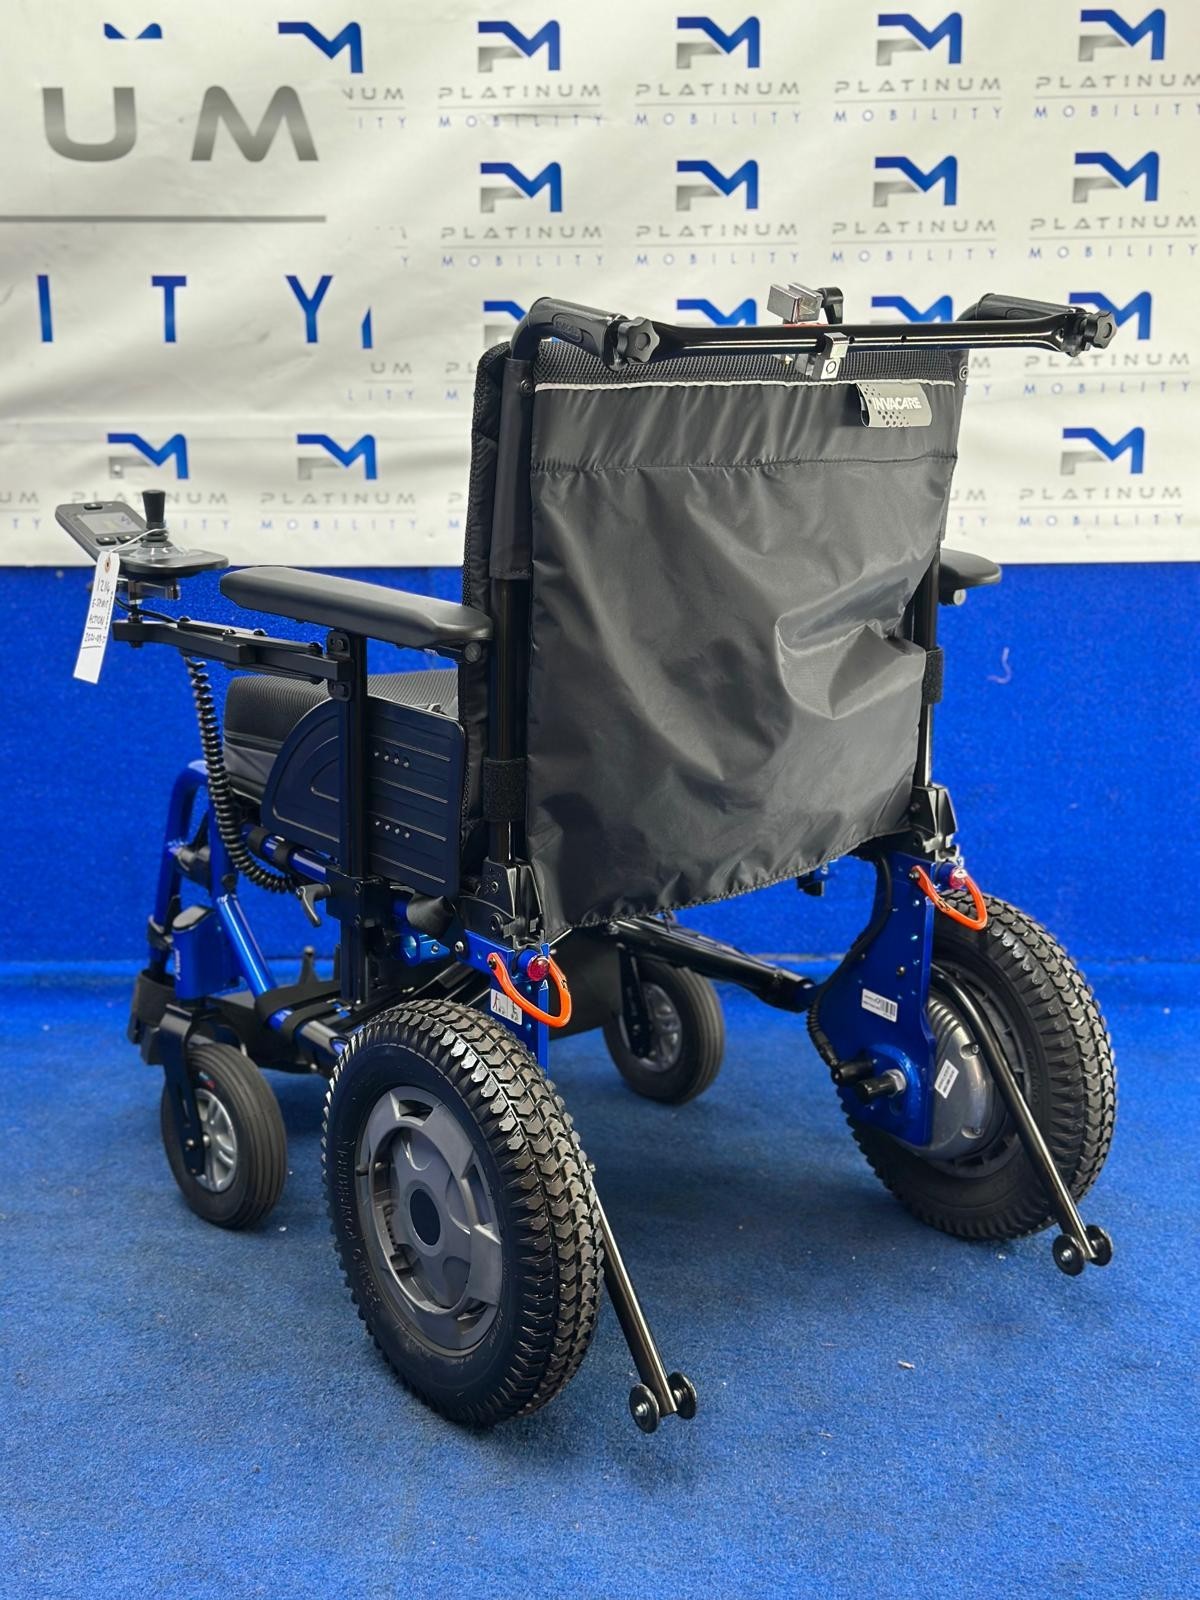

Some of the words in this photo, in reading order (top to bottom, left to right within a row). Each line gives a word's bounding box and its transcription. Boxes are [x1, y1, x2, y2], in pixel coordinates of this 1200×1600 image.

[834, 79, 1000, 93] PLATINUM
[1035, 74, 1200, 89] PLATINUM
[437, 86, 600, 99] PLATINUM
[635, 82, 799, 96] PLATINUM
[438, 115, 604, 128] MOBILITY
[635, 112, 801, 126] MOBILITY
[833, 107, 1003, 122] MOBILITY
[636, 223, 798, 237] PLATINUM
[832, 220, 996, 234] PLATINUM
[1030, 216, 1197, 230] PLATINUM
[441, 226, 602, 239] PLATINUM
[636, 252, 800, 266] MOBILITY
[832, 248, 998, 263] MOBILITY
[1028, 244, 1199, 260] MOBILITY
[441, 254, 604, 268] MOBILITY
[1024, 352, 1191, 368] PLATINUM
[1023, 380, 1192, 396] MOBILITY
[871, 397, 922, 411] INVACARE
[72, 491, 229, 505] PLATNUM
[261, 491, 416, 505] PLATINUM
[1018, 486, 1182, 500] PLATINUM
[260, 519, 417, 531] MOBILITY
[1017, 513, 1184, 526] MOBILITY
